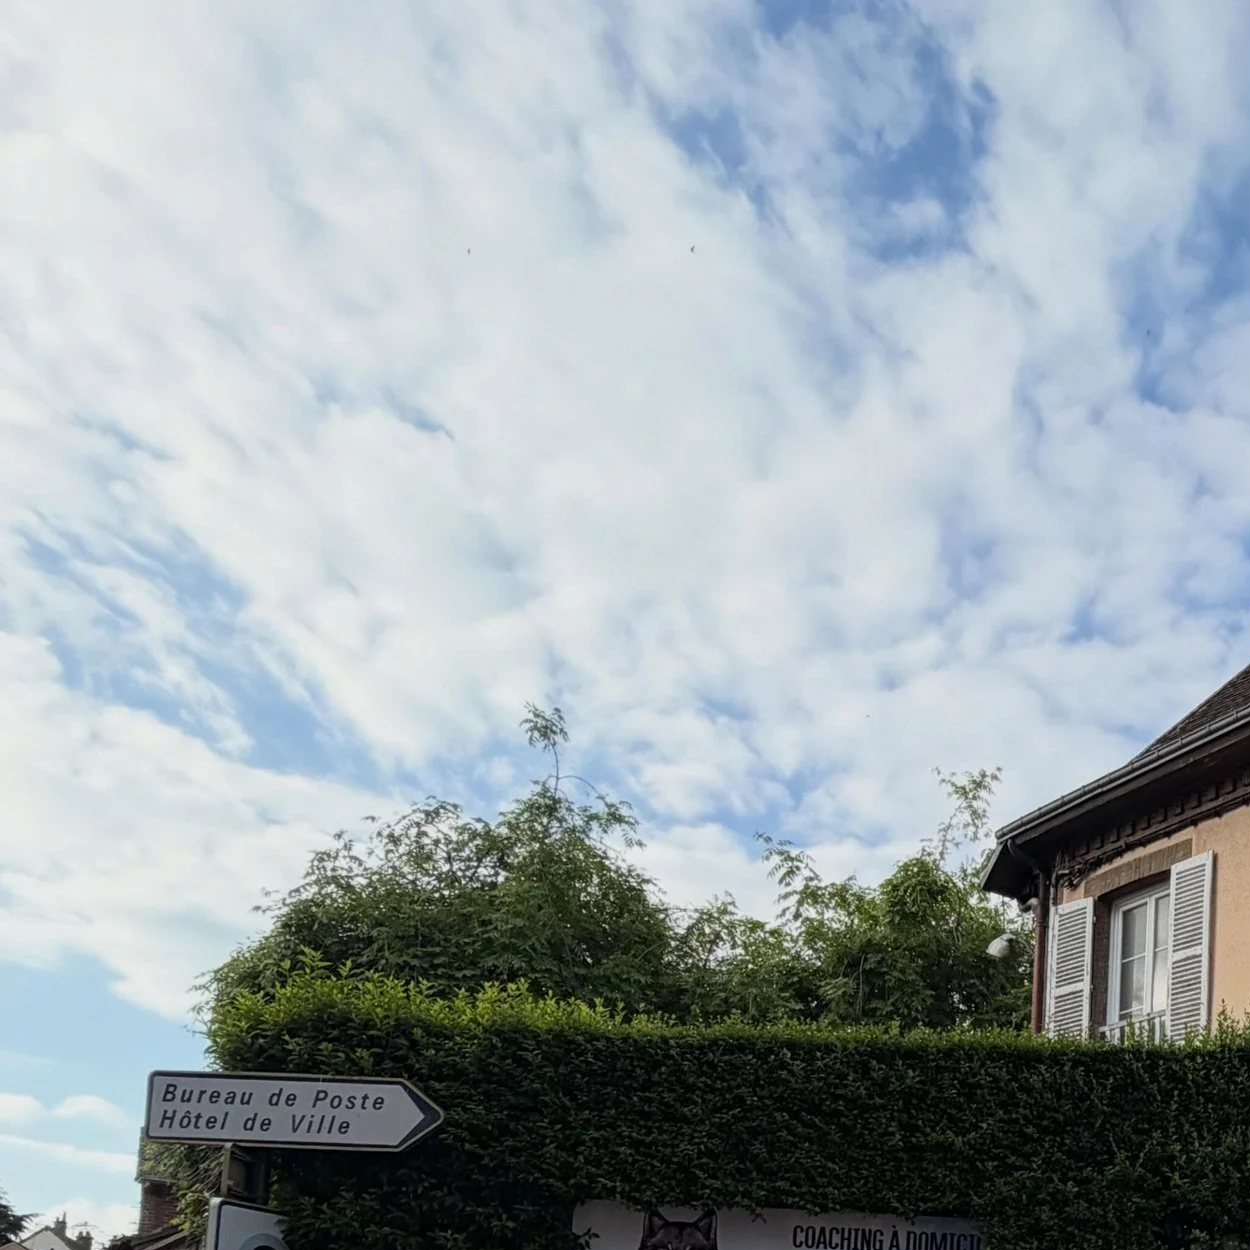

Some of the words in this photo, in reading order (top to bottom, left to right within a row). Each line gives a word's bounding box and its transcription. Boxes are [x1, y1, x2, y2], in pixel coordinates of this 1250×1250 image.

[162, 1083, 253, 1106] Bureau
[268, 1088, 297, 1107] de
[311, 1089, 385, 1111] Poste
[159, 1109, 229, 1130] Hôtel
[243, 1112, 272, 1132] de
[290, 1114, 351, 1135] Ville
